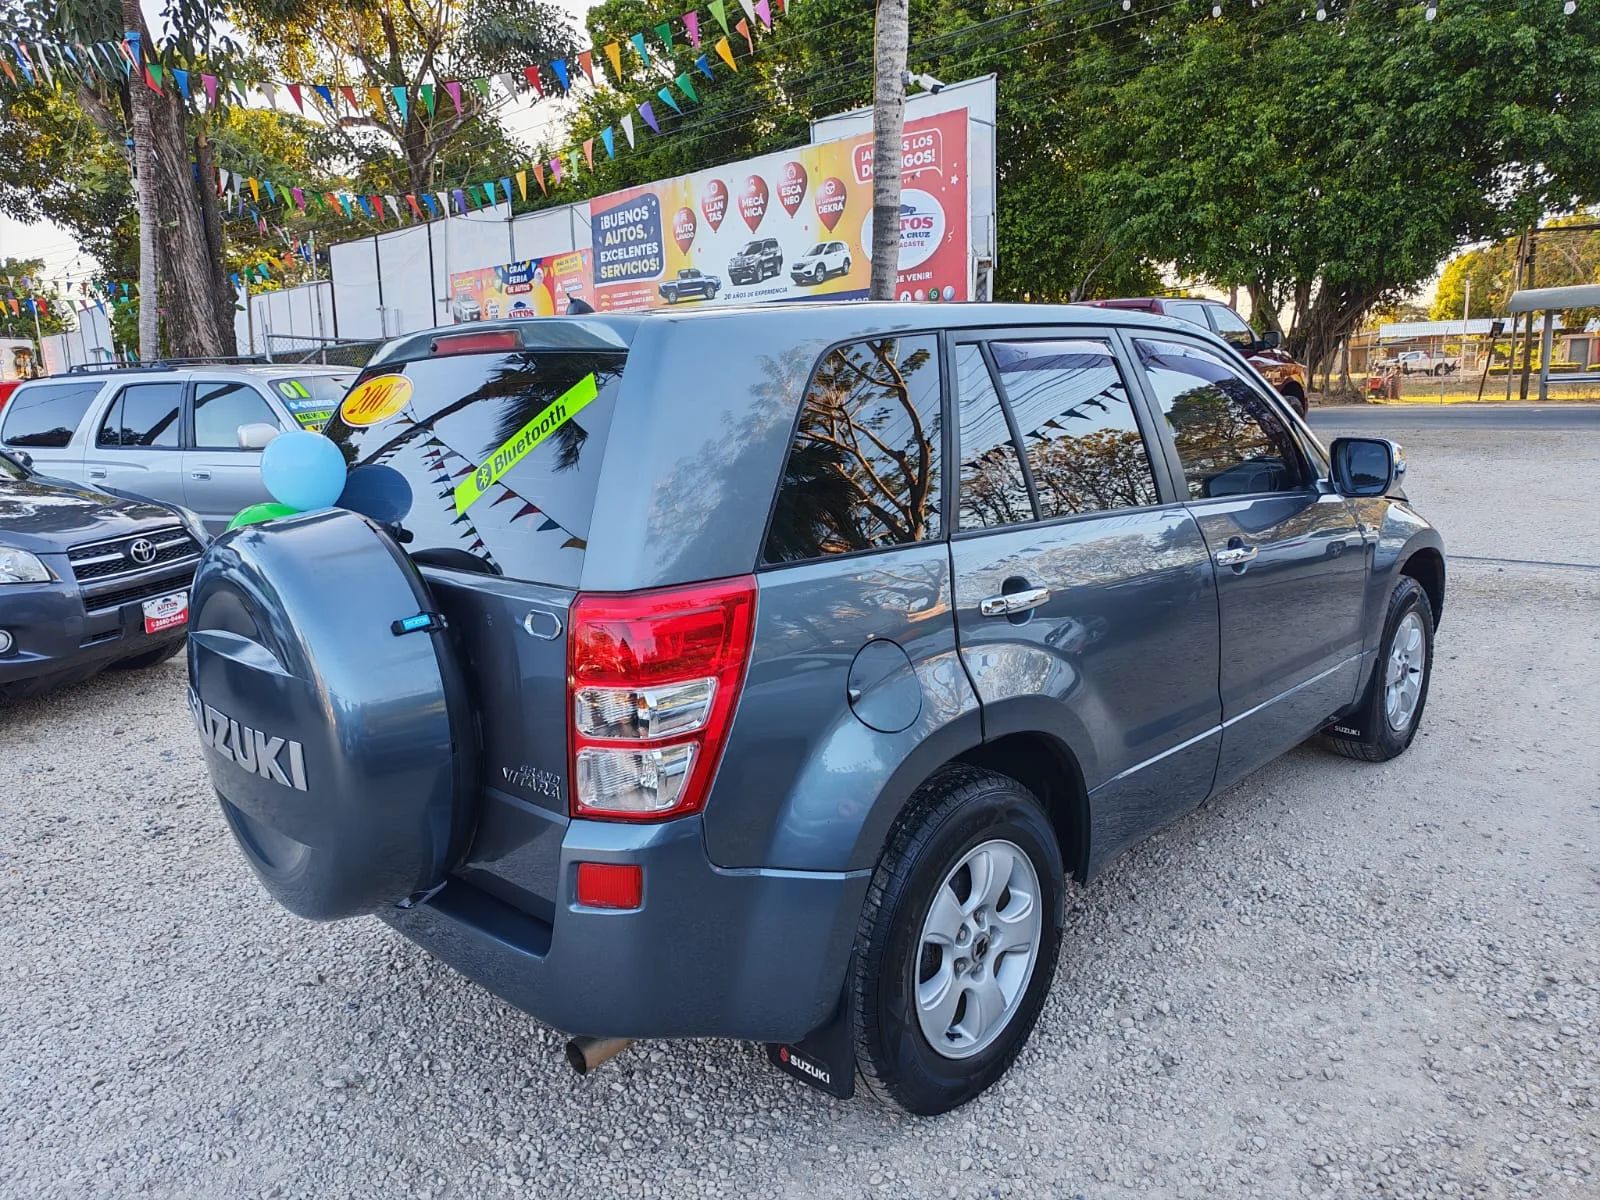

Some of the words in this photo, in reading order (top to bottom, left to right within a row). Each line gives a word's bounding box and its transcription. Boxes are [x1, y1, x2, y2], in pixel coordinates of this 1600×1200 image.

[912, 134, 933, 149] LOS
[781, 185, 802, 197] ESCA
[705, 200, 723, 213] LLAN
[783, 195, 800, 206] NEO
[743, 206, 763, 218] NICA
[818, 202, 844, 214] DEKRA
[600, 205, 649, 230] ¡BUENOS
[706, 211, 722, 223] TAS
[675, 223, 694, 234] AUTO
[604, 224, 647, 246] AUTOS,
[906, 231, 931, 239] CRUZ
[600, 242, 659, 263] EXCELENTES
[509, 264, 527, 274] GRAN
[600, 257, 660, 279] SERVICIOS!
[509, 274, 528, 284] FERIA
[906, 271, 932, 283] VENIR!
[754, 287, 788, 297] EXPERIENCIA
[508, 310, 534, 319] AUTOS
[279, 380, 310, 399] 01
[493, 404, 567, 475] Bluetooth
[1334, 724, 1361, 737] SUZUKI
[790, 1054, 830, 1084] SUZUKI
